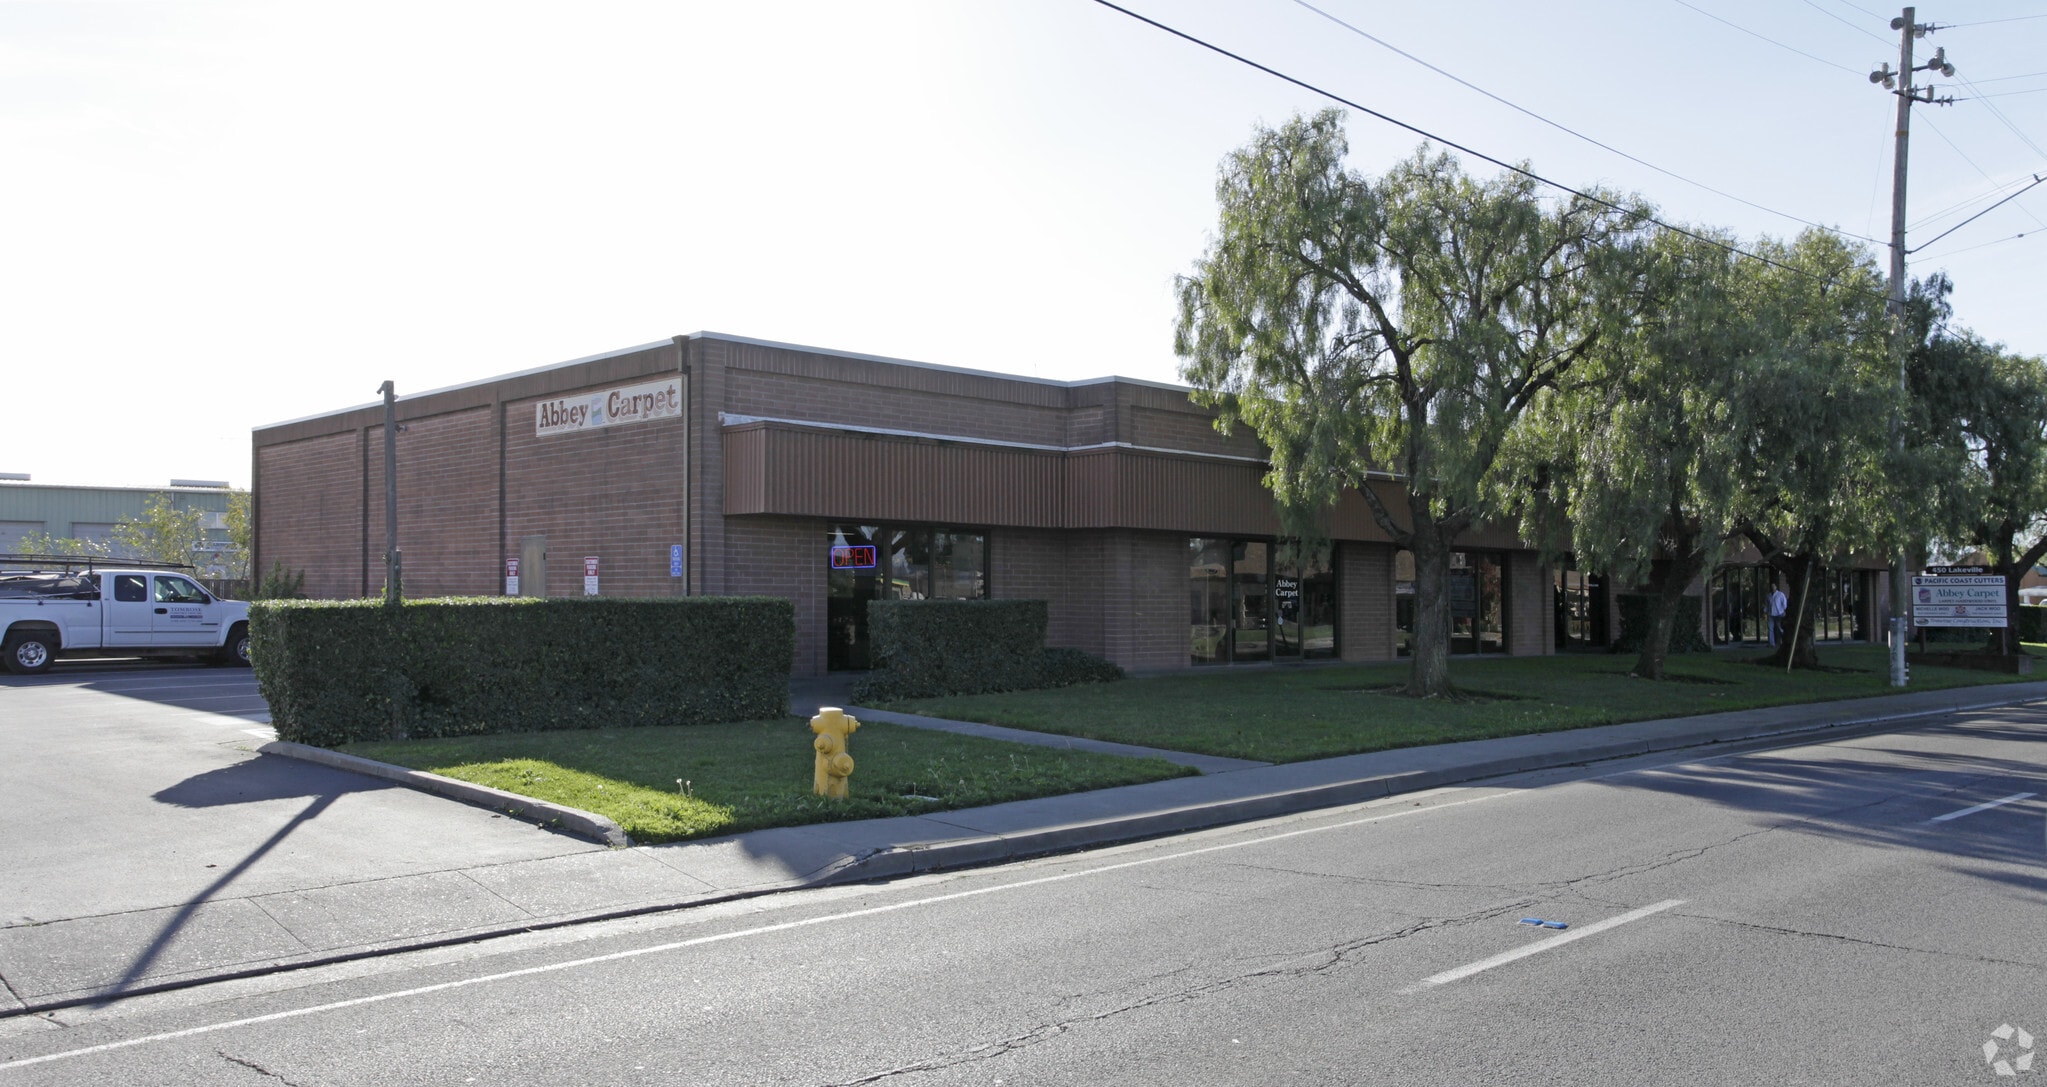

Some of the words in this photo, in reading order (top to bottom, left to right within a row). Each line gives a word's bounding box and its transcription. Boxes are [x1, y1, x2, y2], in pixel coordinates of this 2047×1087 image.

[539, 400, 589, 427] Abbey
[607, 384, 679, 419] Carpet
[833, 547, 874, 566] OPEN
[1276, 580, 1297, 589] Abbey
[1275, 588, 1298, 598] Carpet
[1936, 589, 1965, 598] Abbey
[1967, 589, 1999, 598] Carpet
